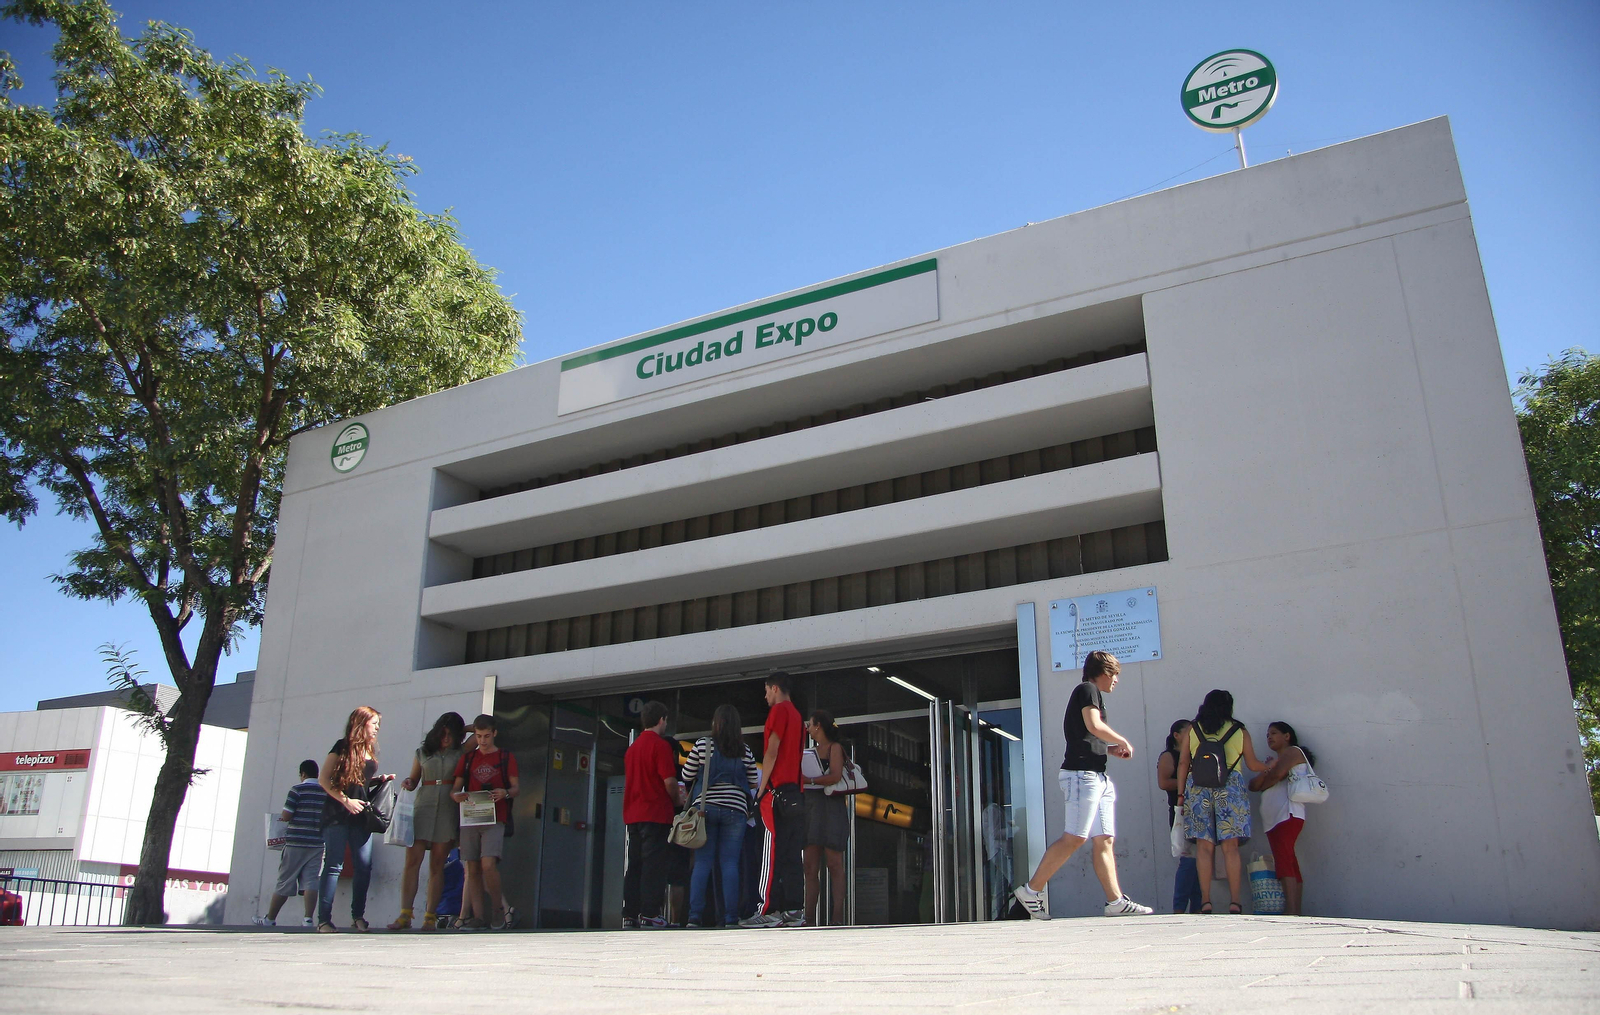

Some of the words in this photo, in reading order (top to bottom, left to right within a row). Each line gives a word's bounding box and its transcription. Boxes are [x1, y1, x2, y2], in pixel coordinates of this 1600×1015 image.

[1198, 76, 1258, 103] Metro
[636, 331, 743, 380] Ciudad
[755, 311, 838, 348] Expo
[338, 442, 362, 454] Metro
[16, 754, 55, 766] telepizza
